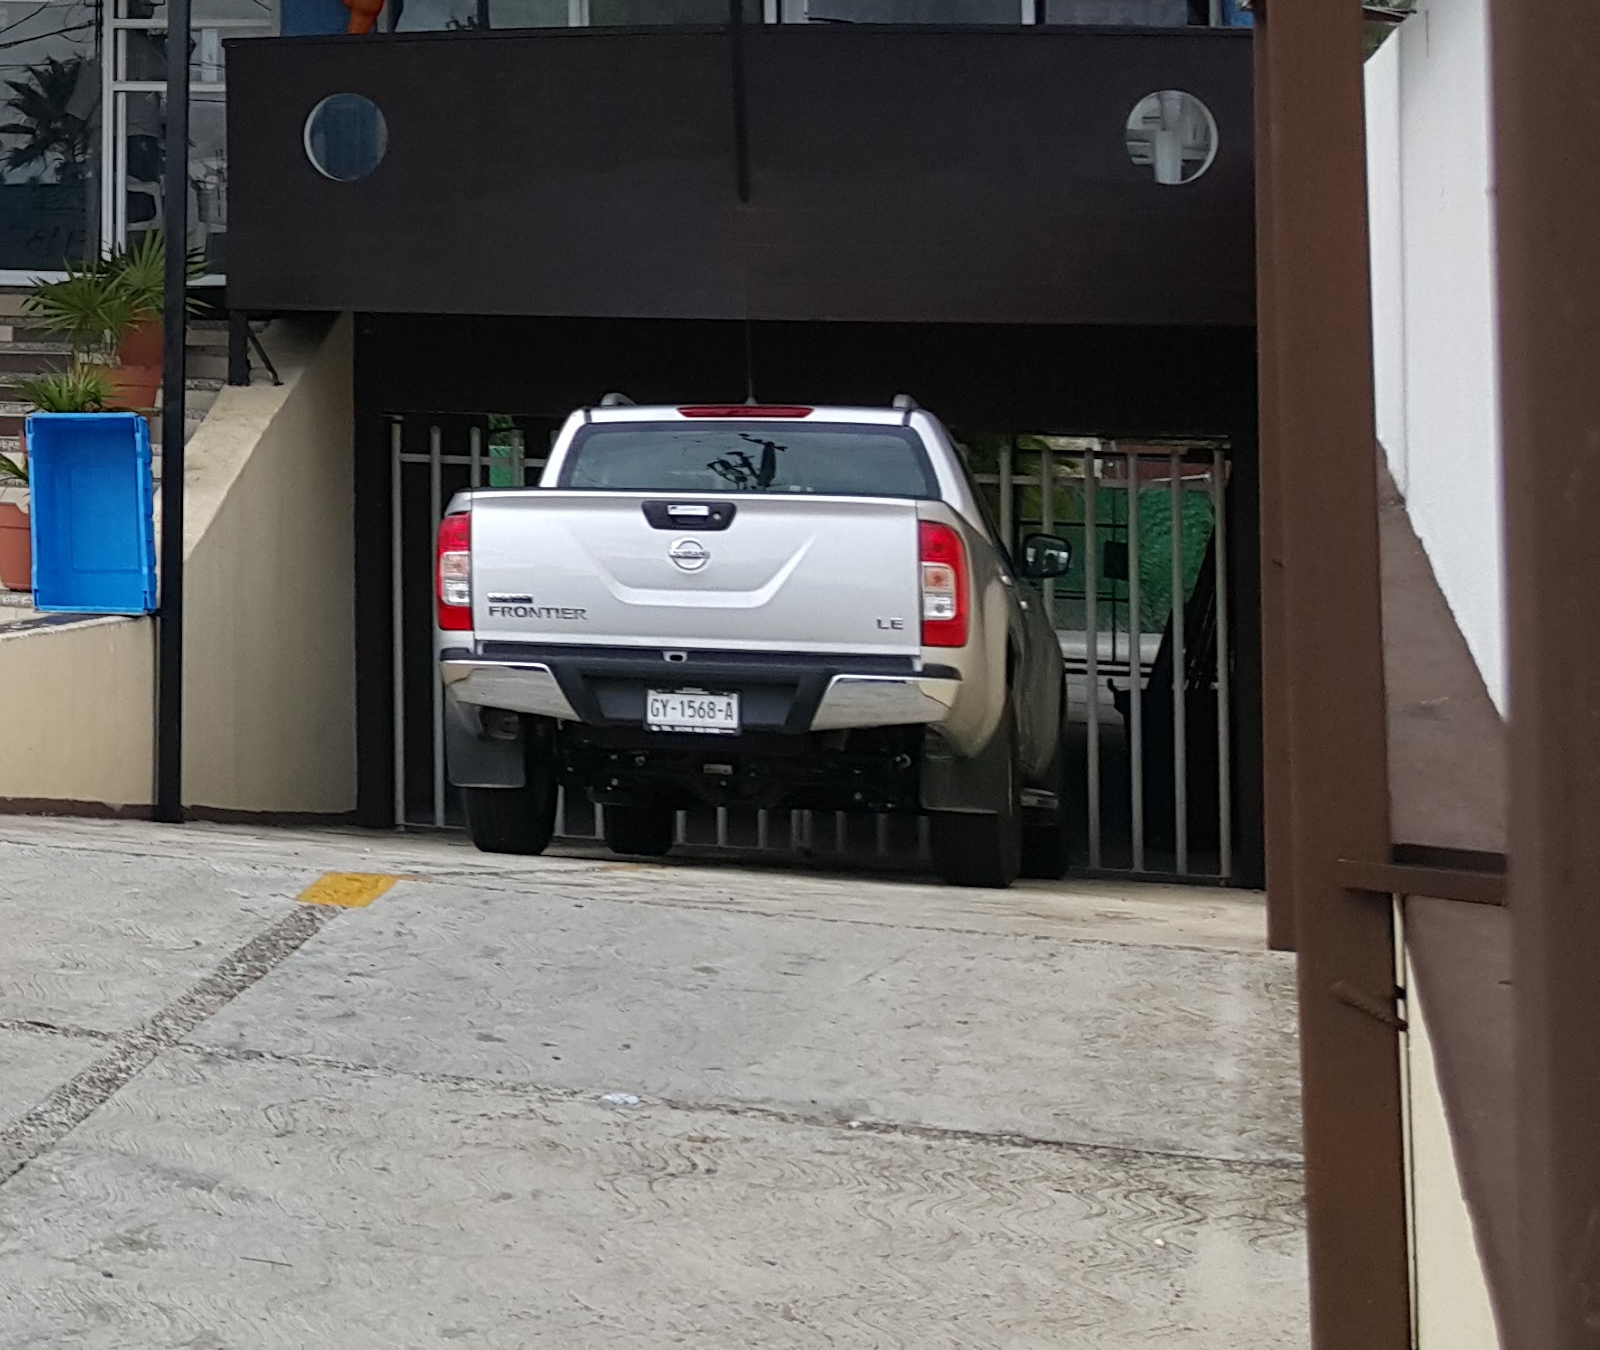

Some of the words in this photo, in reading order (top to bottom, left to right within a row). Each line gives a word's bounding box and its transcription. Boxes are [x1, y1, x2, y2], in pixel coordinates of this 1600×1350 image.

[488, 606, 588, 620] FRONTIER
[876, 617, 904, 630] LE
[650, 698, 734, 721] GY-1568-A
